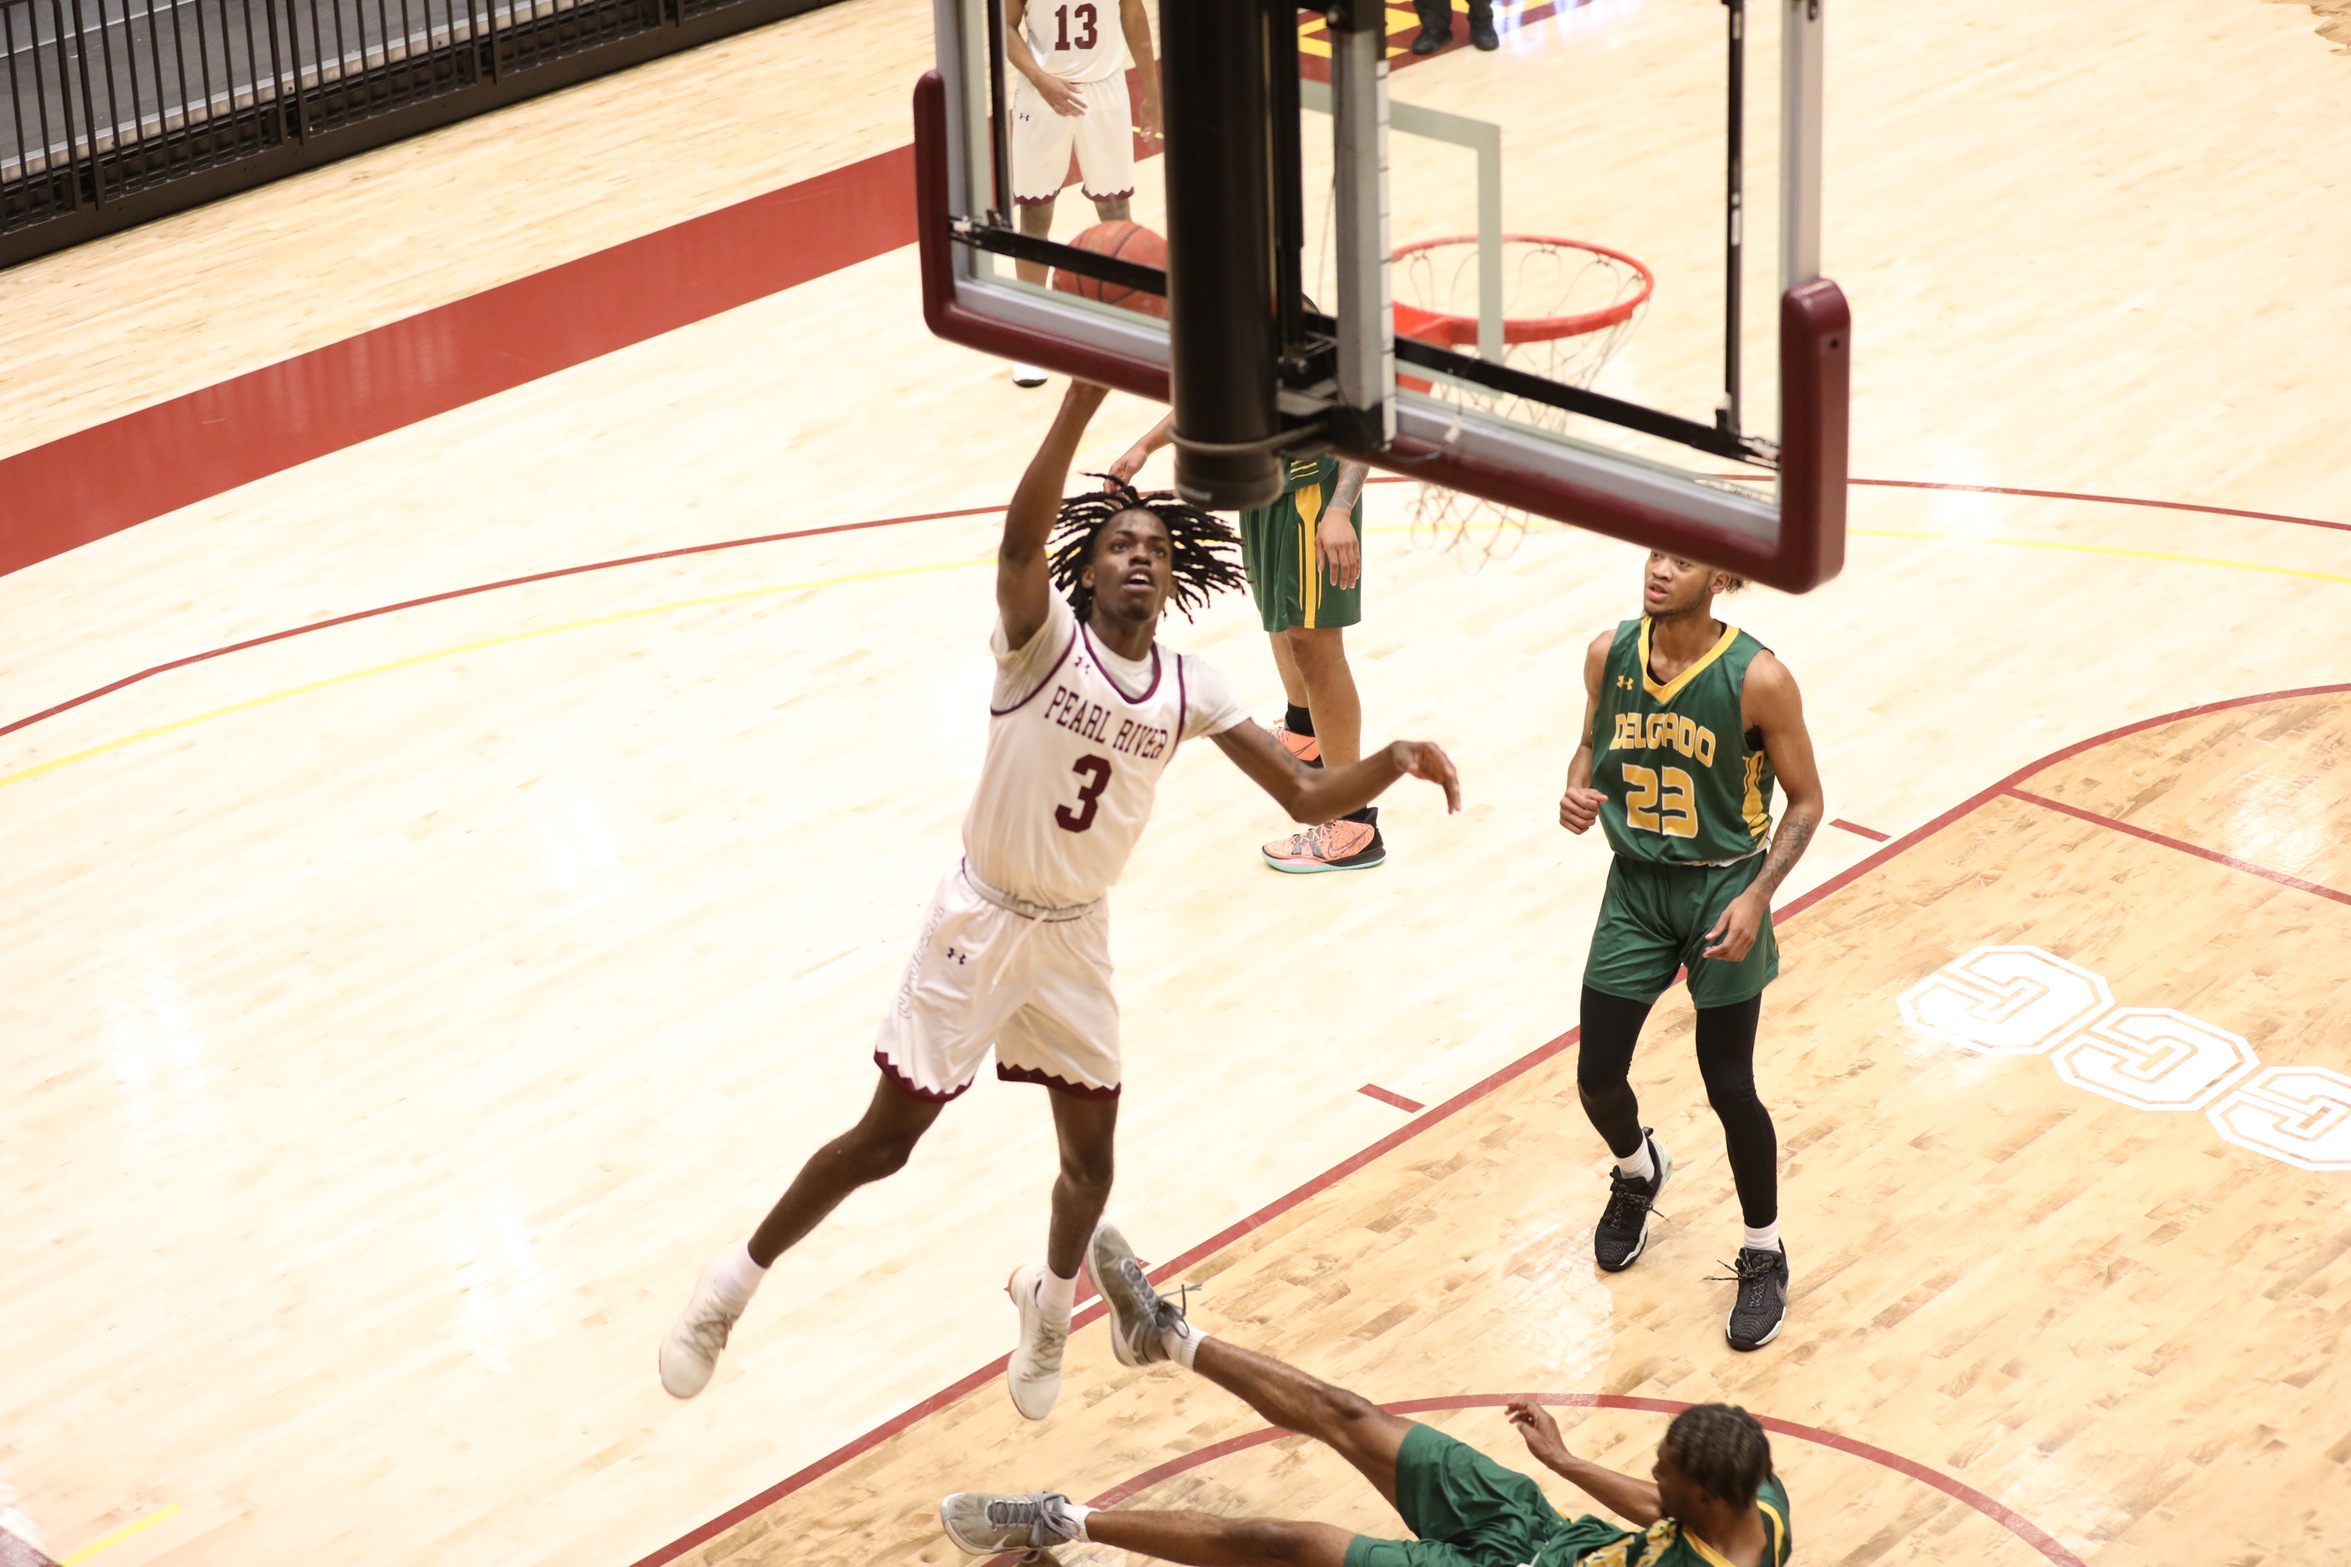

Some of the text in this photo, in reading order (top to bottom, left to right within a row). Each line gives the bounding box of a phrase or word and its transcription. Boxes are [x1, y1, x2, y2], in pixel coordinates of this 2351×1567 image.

[1054, 3, 1098, 51] 13
[1044, 685, 1168, 760] PEARL RIVER
[1608, 711, 1716, 768] DELGADO
[1054, 753, 1112, 833] 3
[1622, 762, 1699, 839] 23
